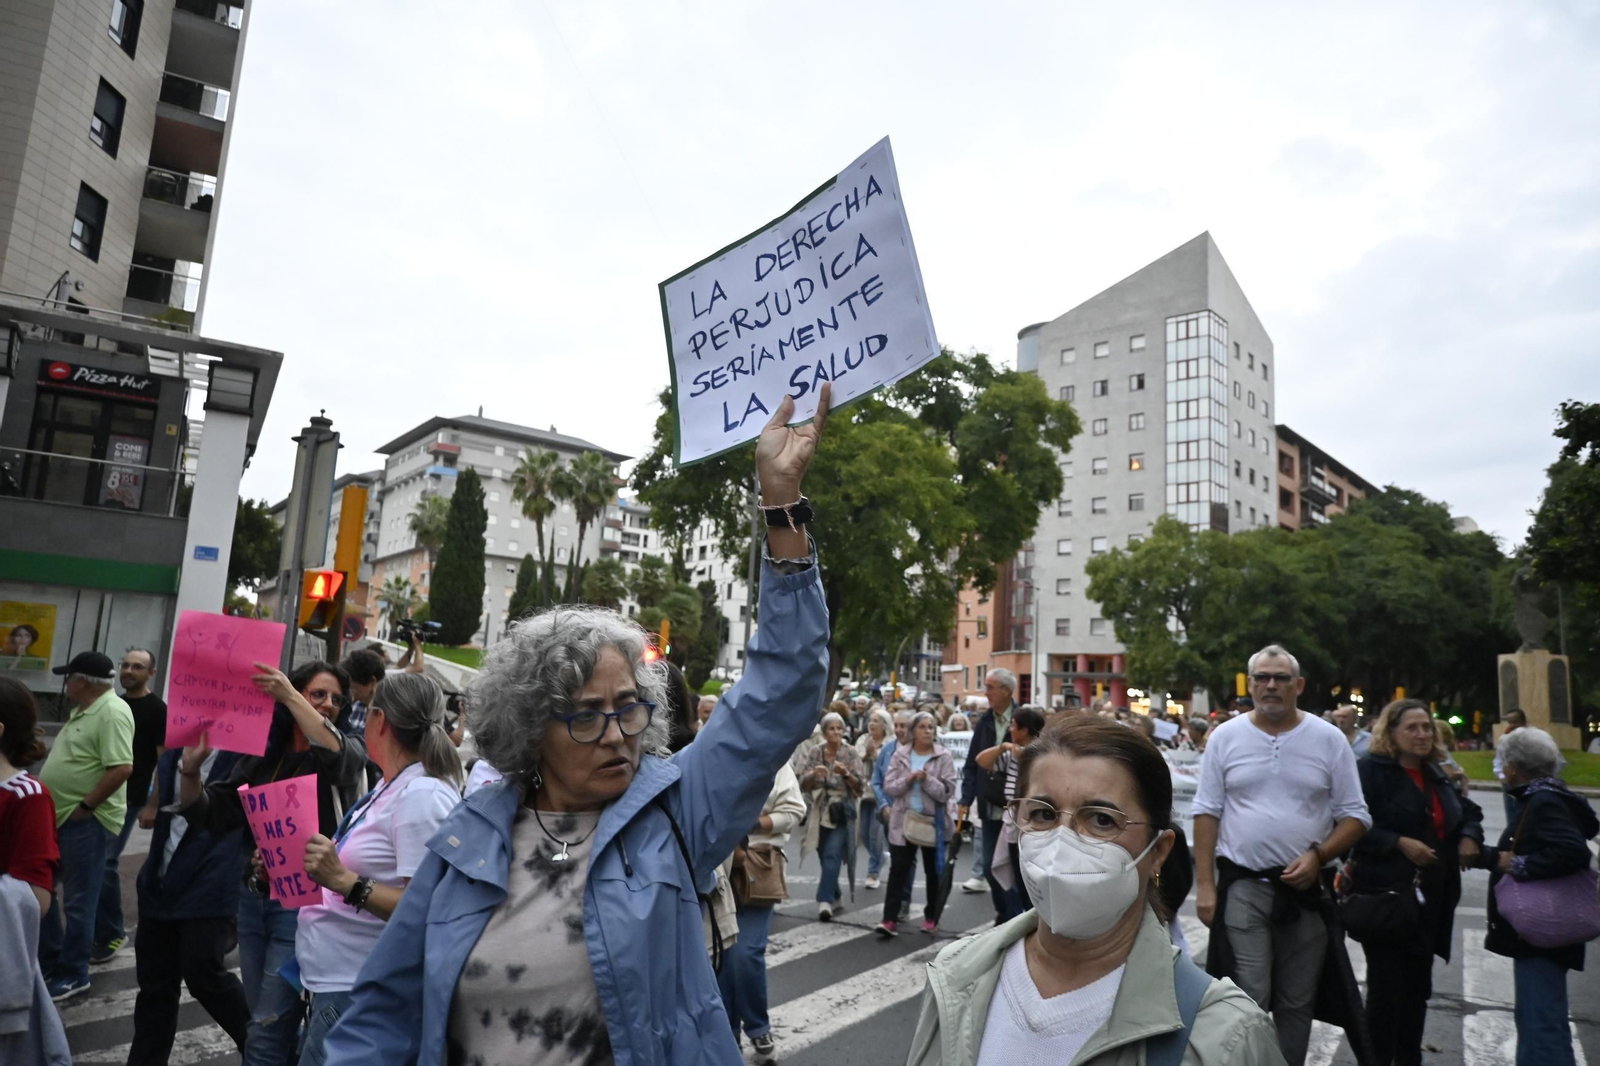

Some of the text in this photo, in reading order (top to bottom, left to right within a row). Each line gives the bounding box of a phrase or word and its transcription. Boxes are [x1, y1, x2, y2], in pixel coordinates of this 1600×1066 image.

[691, 175, 883, 320] LA DERECHA
[73, 367, 152, 391] Pizza Hut
[722, 333, 888, 433] LA SALUD
[233, 703, 263, 716] VIDA
